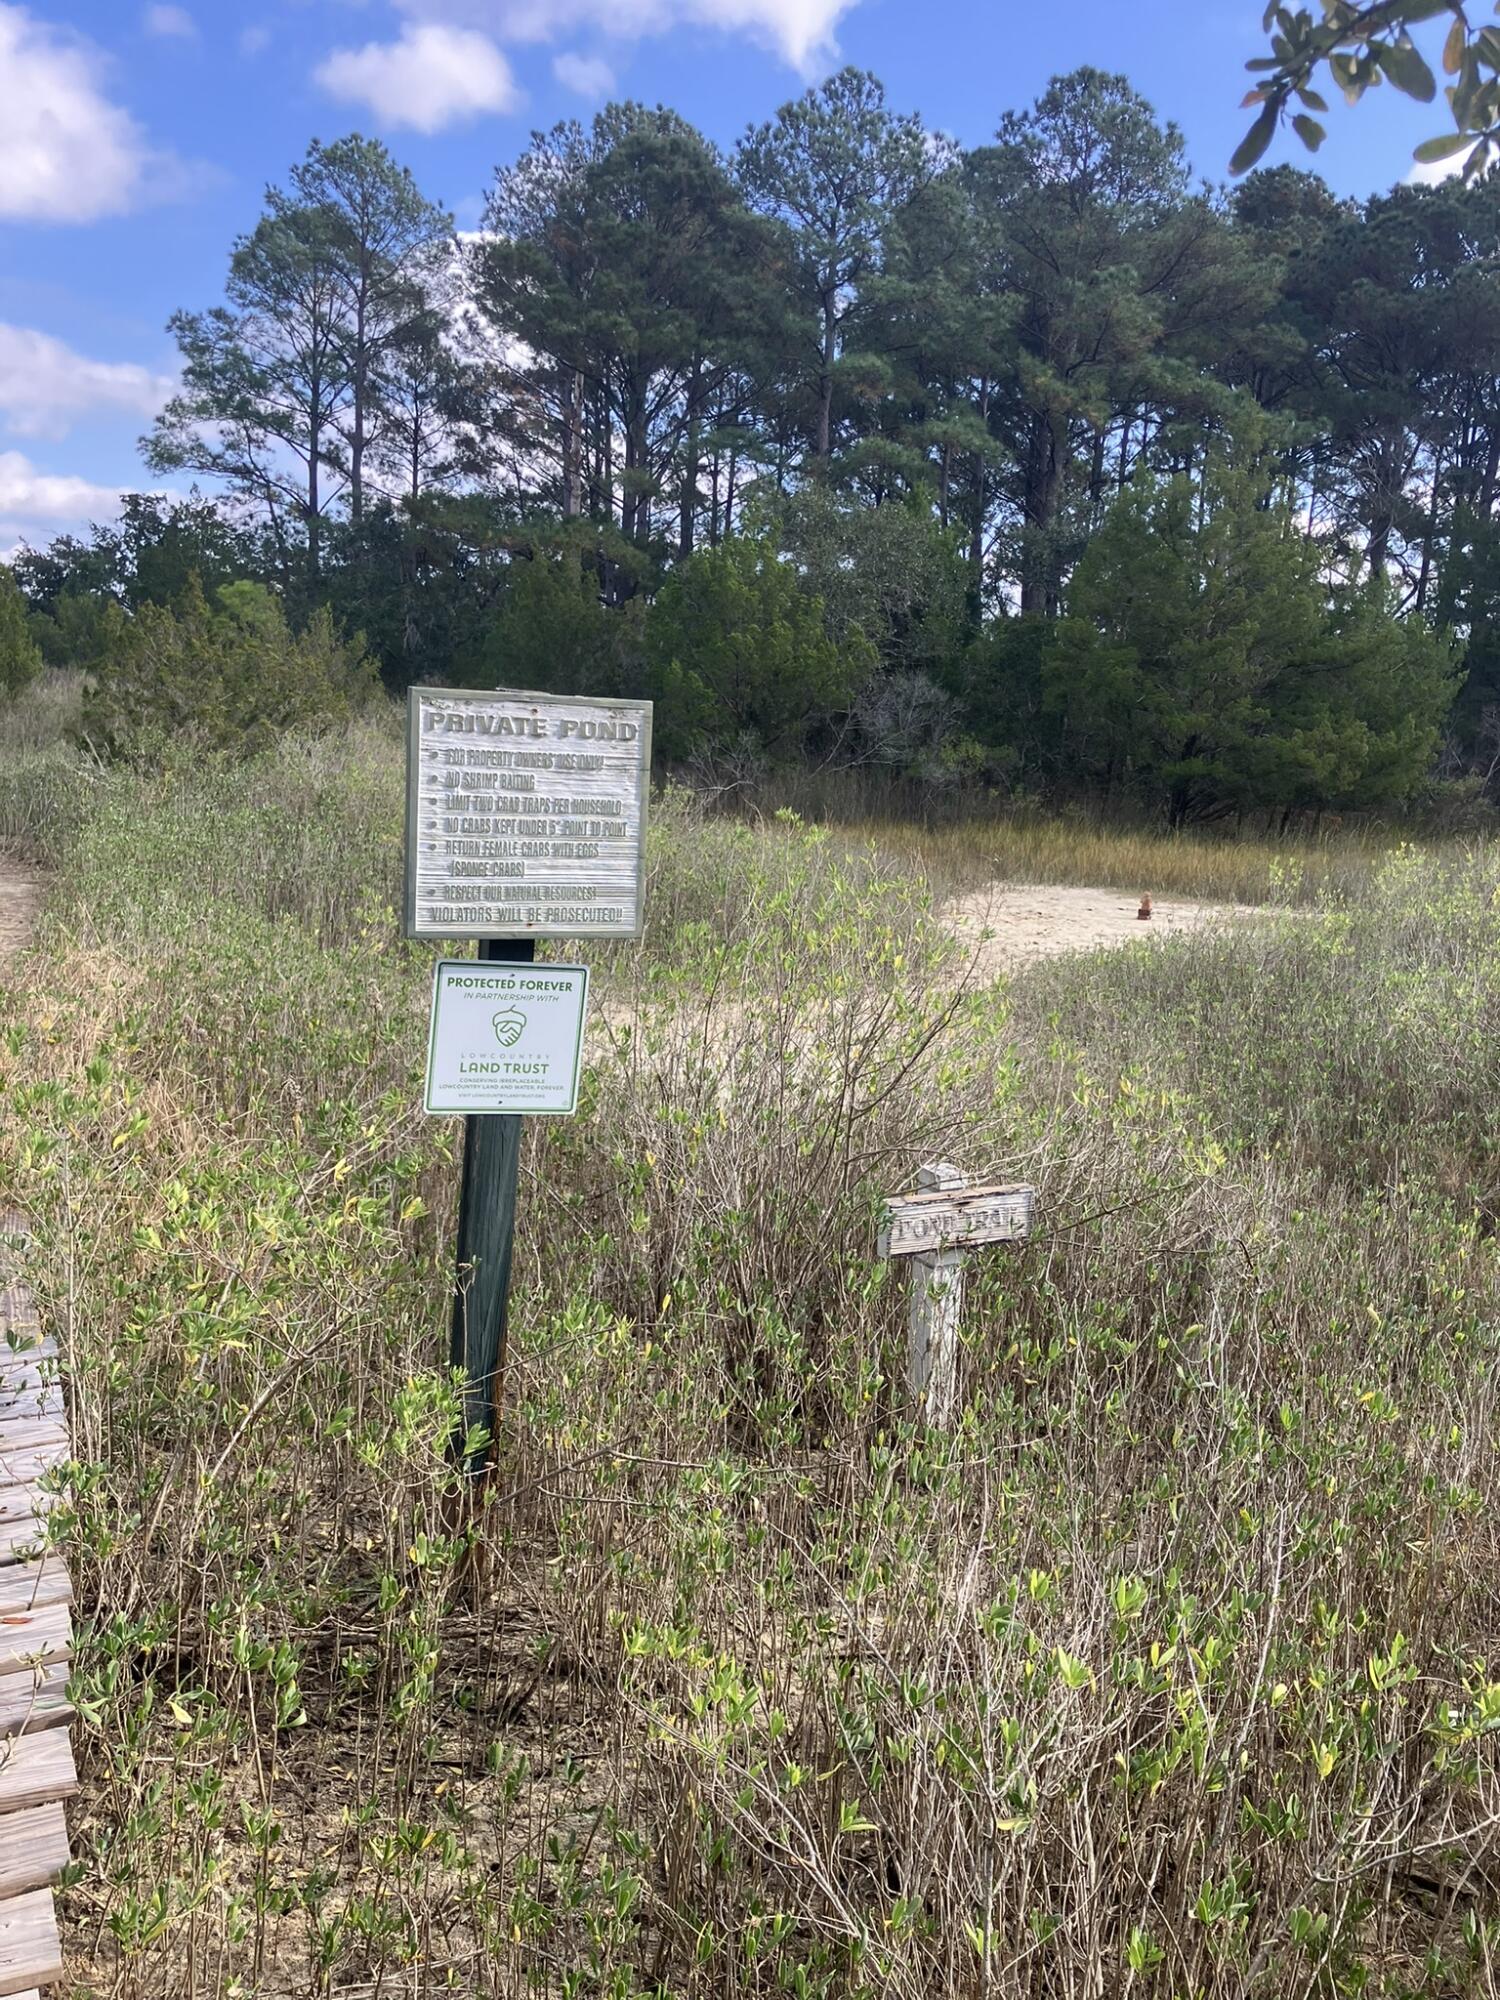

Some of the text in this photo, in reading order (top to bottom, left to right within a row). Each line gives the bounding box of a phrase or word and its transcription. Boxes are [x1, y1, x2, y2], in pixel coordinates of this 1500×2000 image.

[428, 712, 637, 741] PRIVATE POND
[447, 748, 465, 765] FOR
[467, 749, 513, 767] PROPERTY
[557, 753, 576, 770] USE
[447, 771, 535, 791] NO SHRIMP BAITING
[447, 794, 622, 816] LIMIT TWO CRAB TRAPS PER HOUSEHOLD
[447, 817, 459, 833] NO
[462, 818, 491, 834] CRABS
[495, 818, 517, 835] KEPT
[519, 819, 547, 836] UNDER
[565, 821, 588, 836] POINT
[591, 821, 601, 837] TO
[603, 822, 628, 837] POINT
[446, 840, 599, 858] RETURN FEMALE CRABS WITH EGGS
[451, 860, 525, 878] (SPONGE CRABS)
[446, 885, 482, 900] RESPECT
[484, 886, 502, 900] OUR
[505, 886, 544, 900] NATURAL
[432, 907, 492, 922] VIOLATORS
[498, 907, 523, 922] WILL
[528, 907, 542, 922] BE
[447, 977, 573, 992] PROTECTED FOREVER
[475, 992, 535, 1001] PARTNERSHIP
[536, 994, 559, 1002] WITH
[460, 1062, 549, 1074] LAND TRUST
